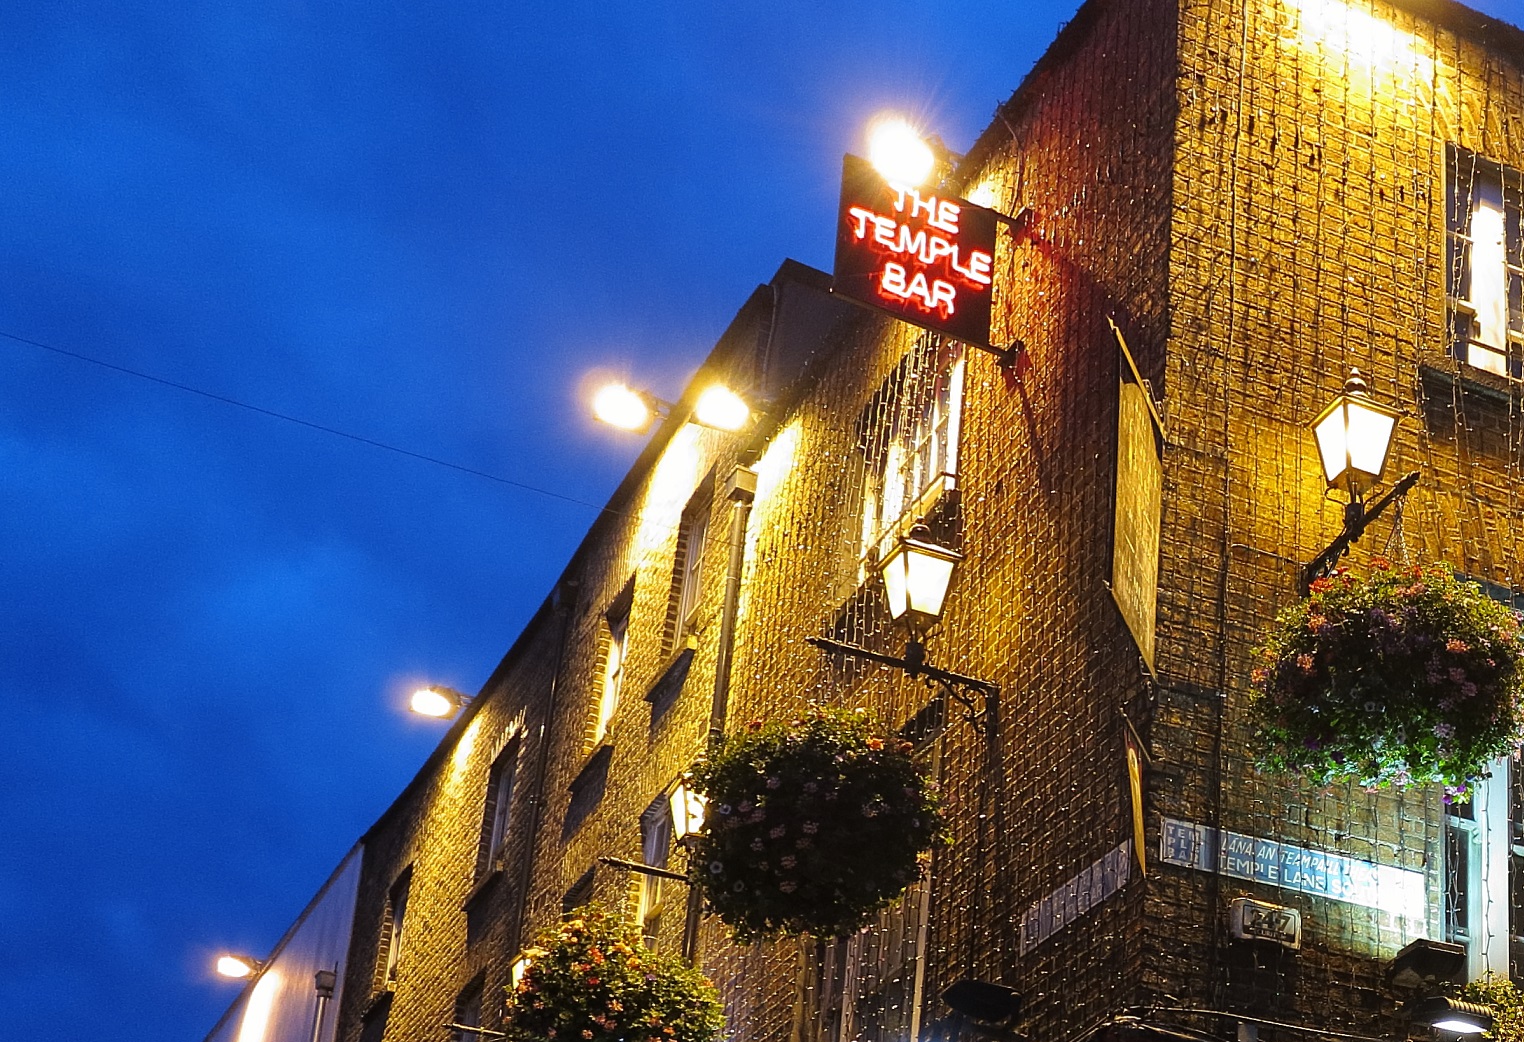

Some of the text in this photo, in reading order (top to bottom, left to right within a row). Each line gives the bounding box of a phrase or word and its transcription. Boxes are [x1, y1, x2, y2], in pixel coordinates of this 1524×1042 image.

[891, 182, 961, 234] THE
[850, 206, 992, 285] TEMPLE
[882, 263, 956, 314] BAR
[1257, 844, 1275, 861] AN
[1284, 868, 1325, 891] LANE
